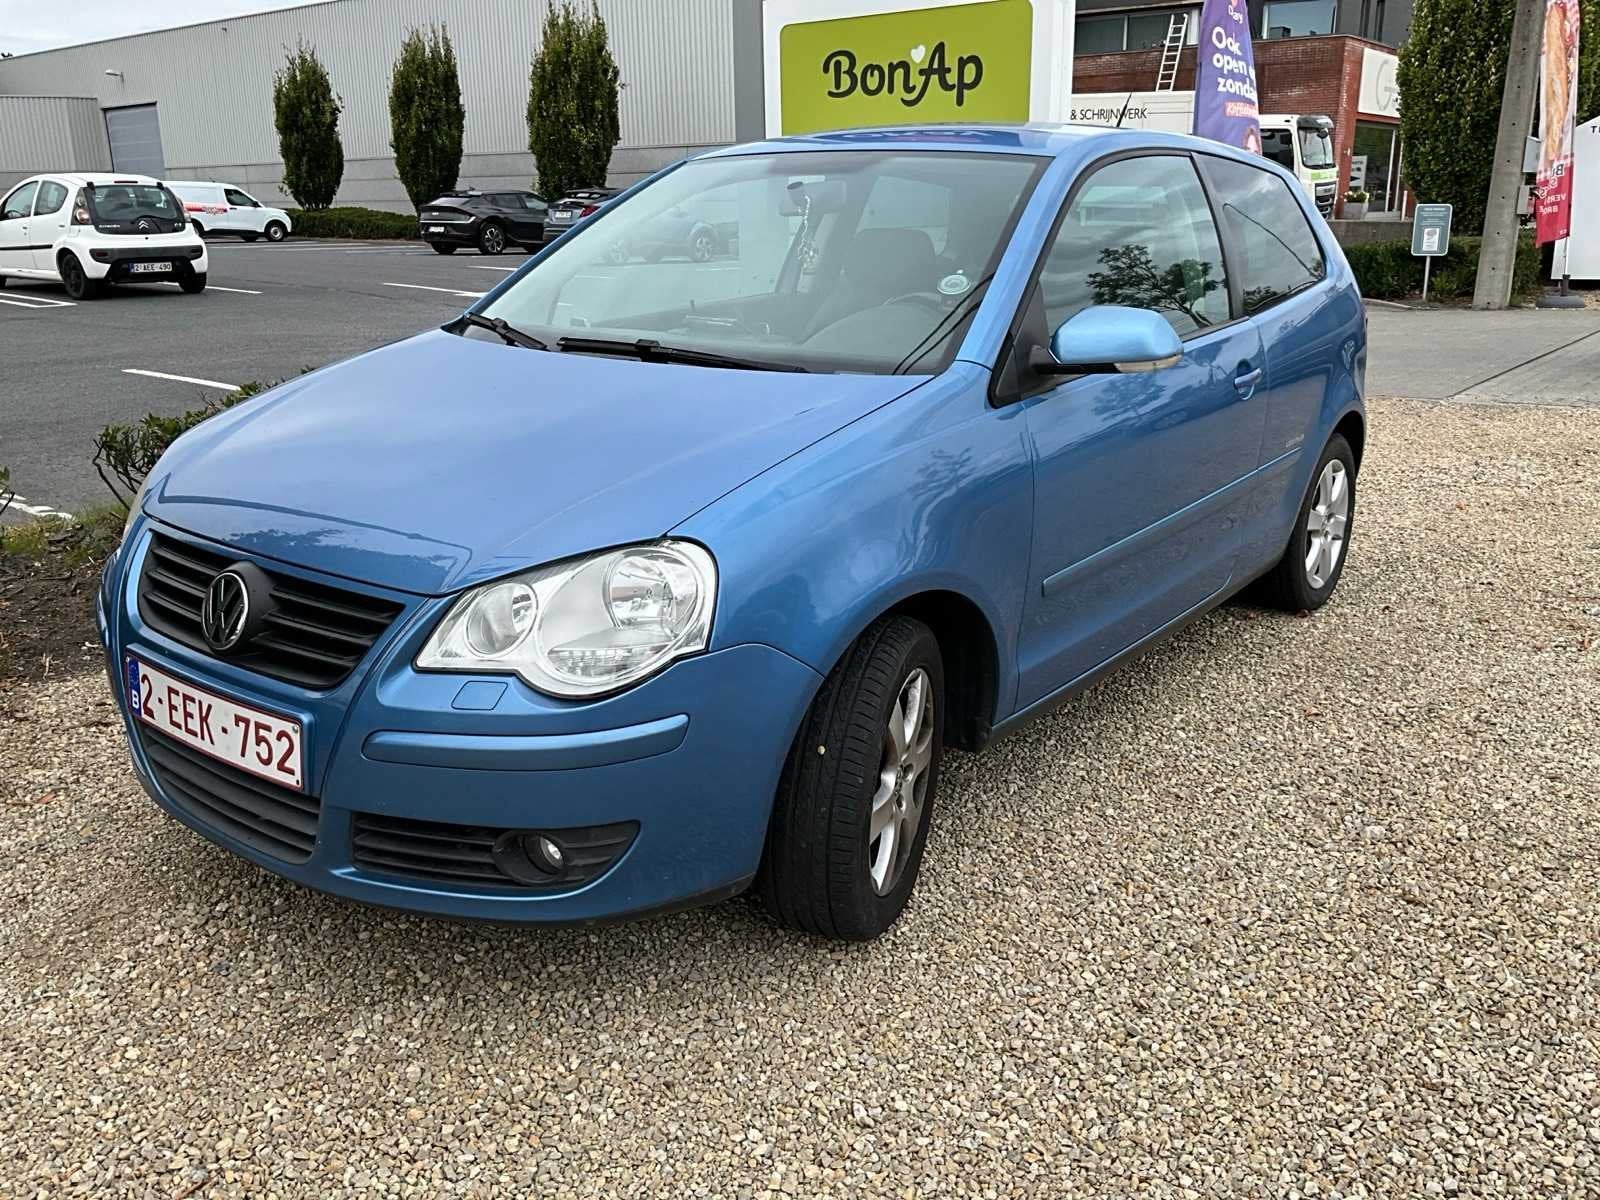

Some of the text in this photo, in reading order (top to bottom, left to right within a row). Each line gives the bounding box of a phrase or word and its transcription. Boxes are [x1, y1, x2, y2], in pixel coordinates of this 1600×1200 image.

[822, 41, 984, 107] BonAp
[1212, 53, 1248, 75] open
[1079, 108, 1148, 123] SCHRIJNWERK
[130, 689, 140, 709] B
